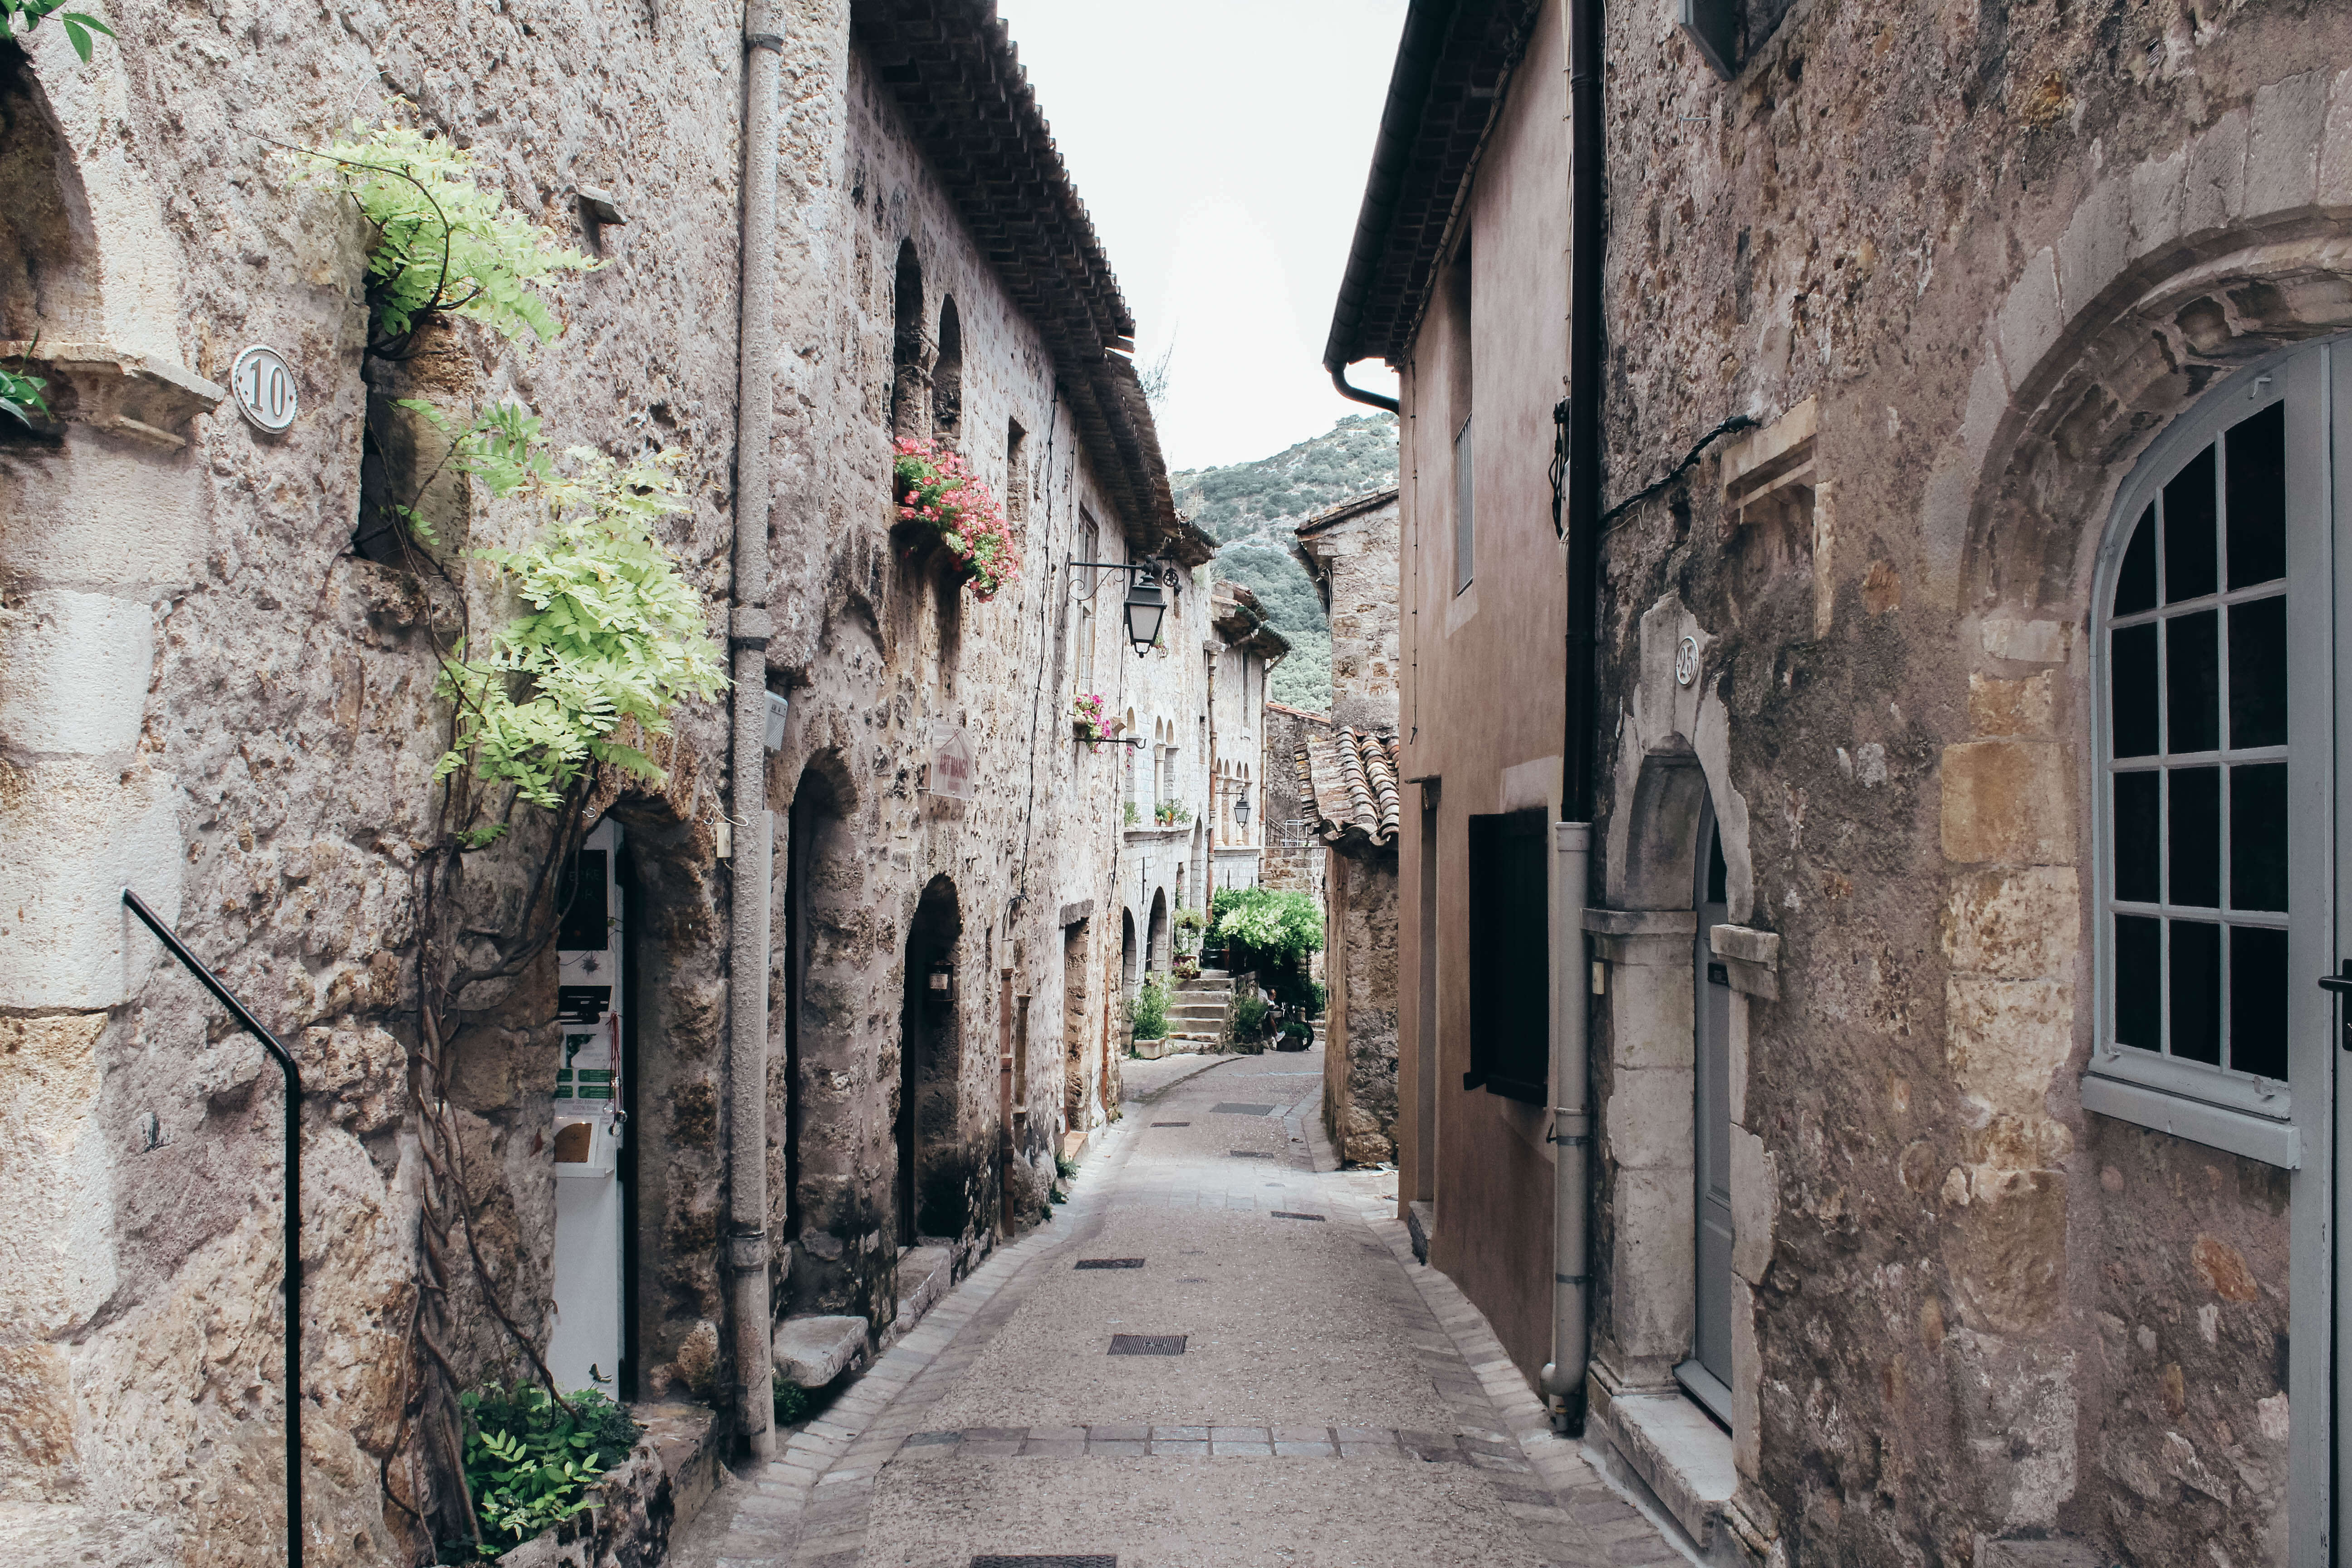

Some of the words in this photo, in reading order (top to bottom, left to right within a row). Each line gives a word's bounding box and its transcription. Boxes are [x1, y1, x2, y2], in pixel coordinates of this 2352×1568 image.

[250, 358, 286, 417] 10
[1680, 645, 1694, 679] 25
[939, 753, 951, 775] ART
[951, 756, 968, 780] MANGO
